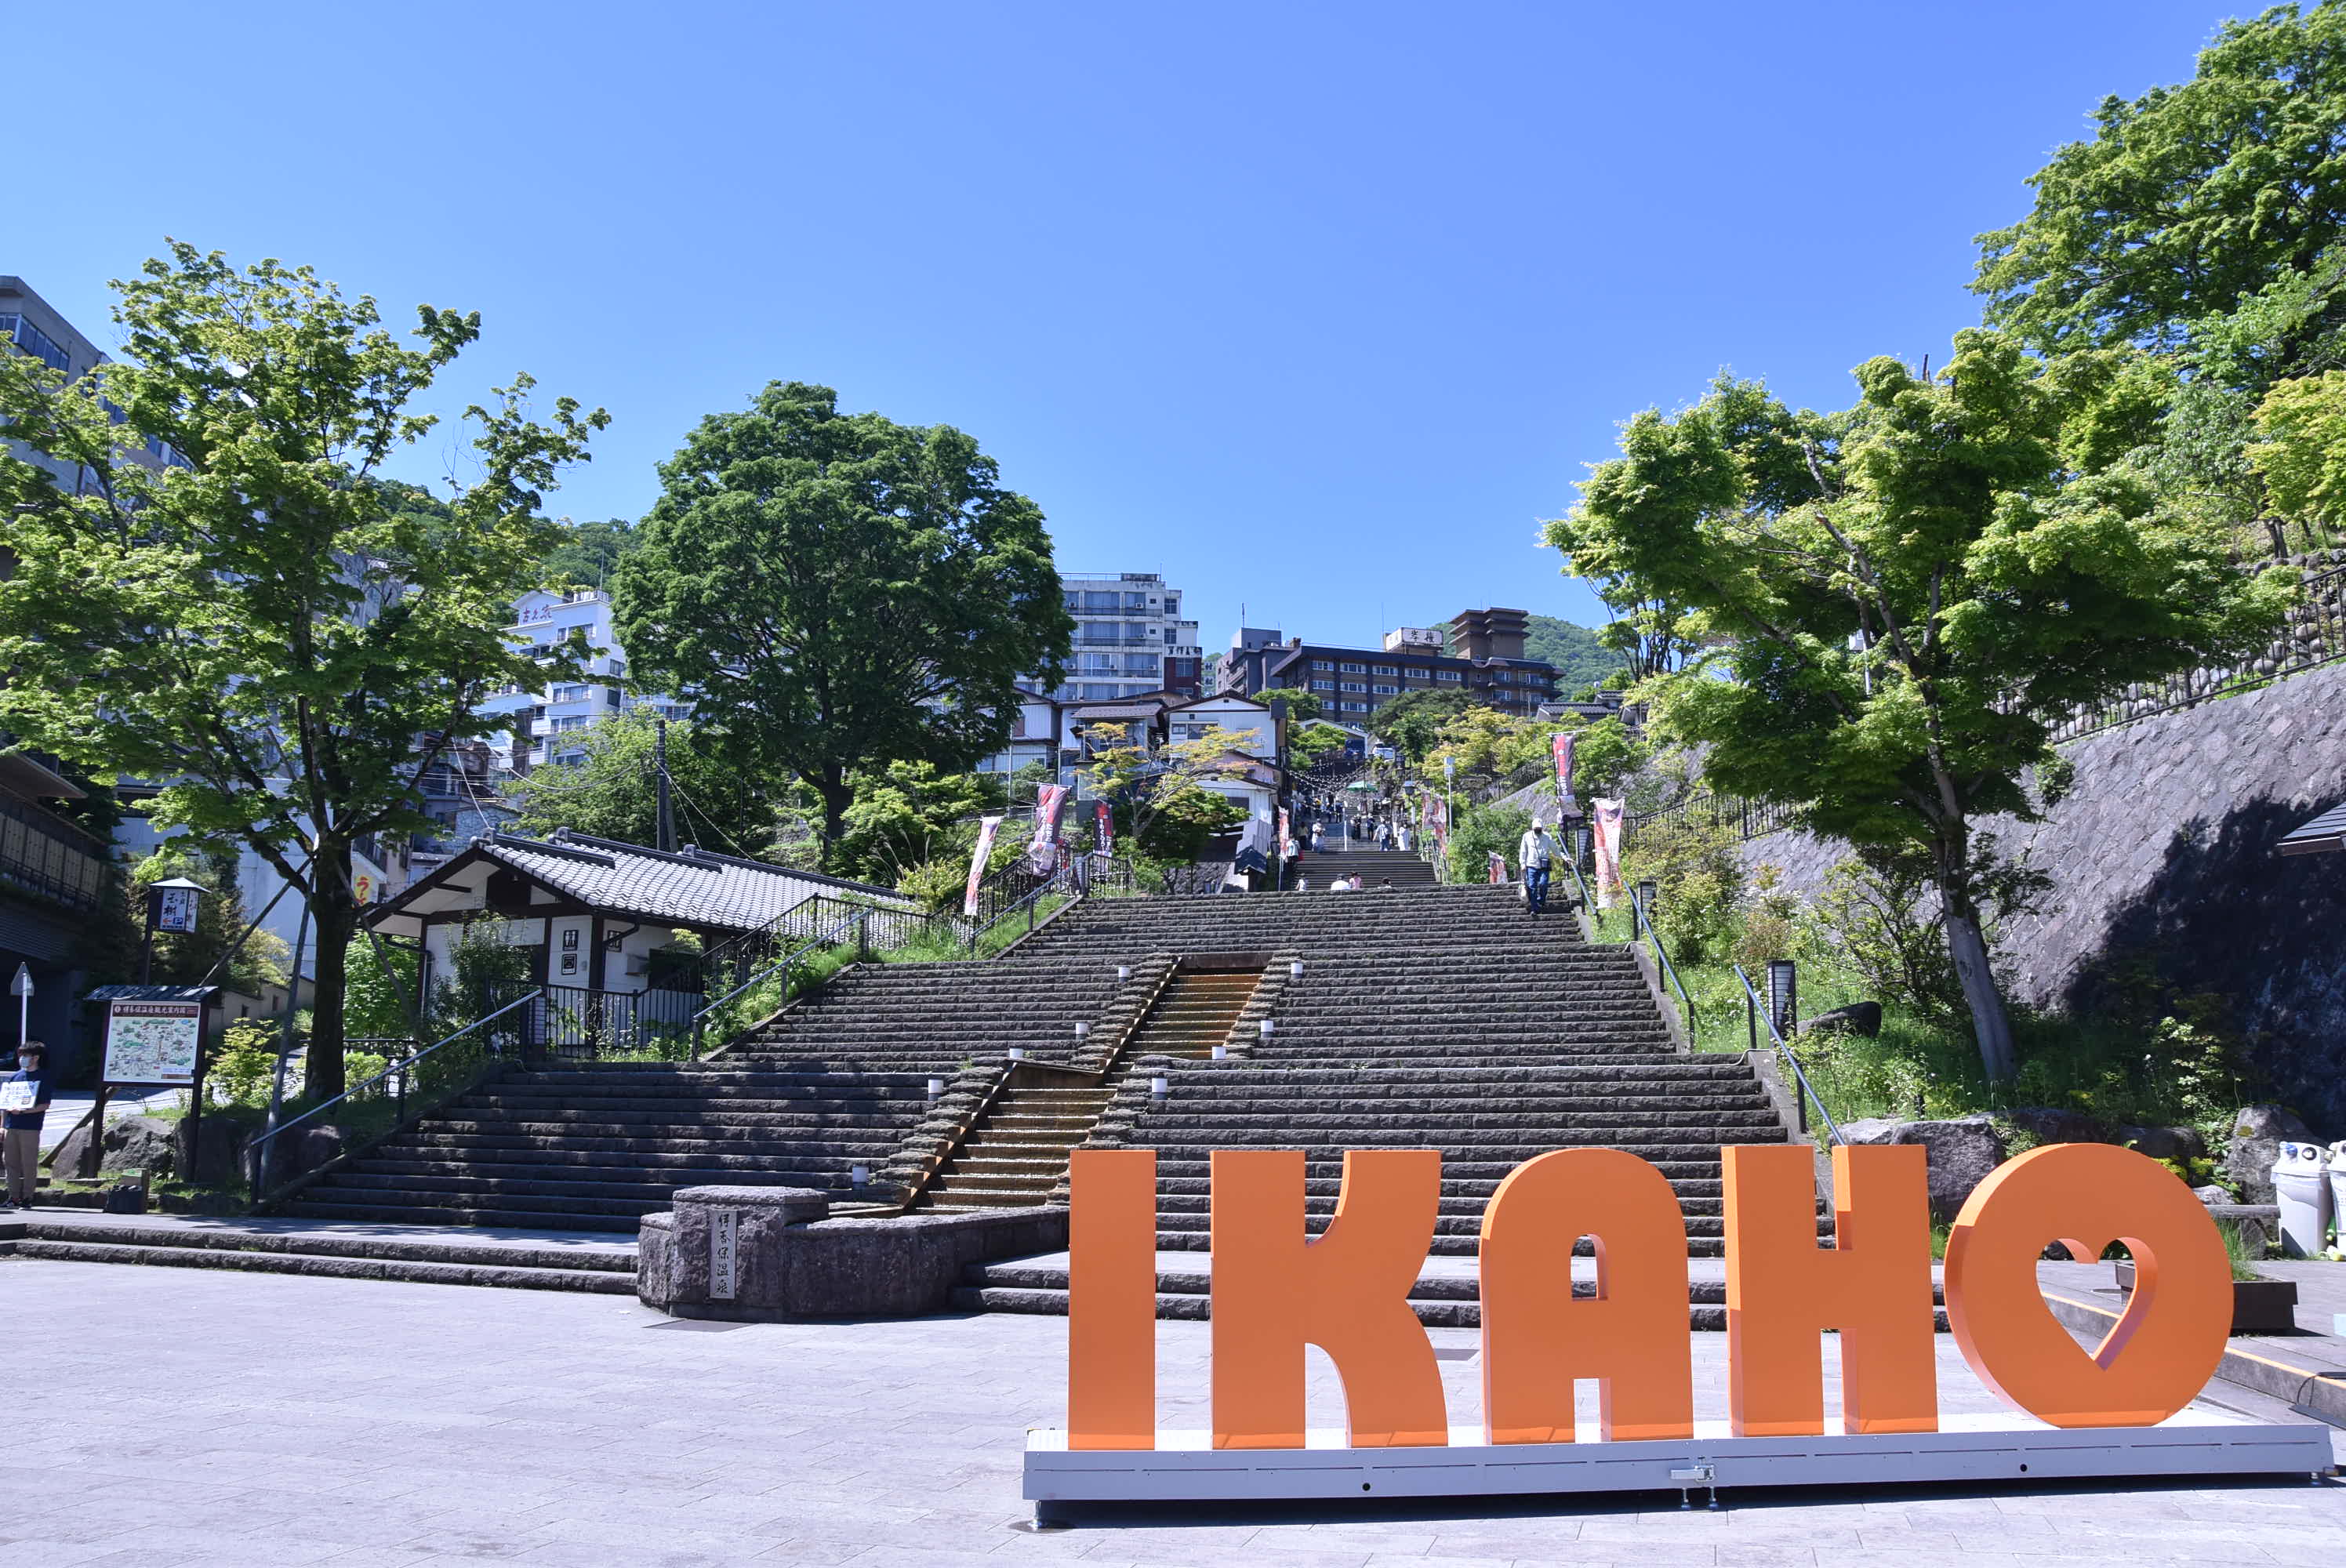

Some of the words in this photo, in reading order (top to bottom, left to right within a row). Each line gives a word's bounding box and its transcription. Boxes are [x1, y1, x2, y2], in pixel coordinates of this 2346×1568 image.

[717, 1213, 732, 1294] 伊香保温泉
[1068, 1142, 2234, 1450] IKAHO
